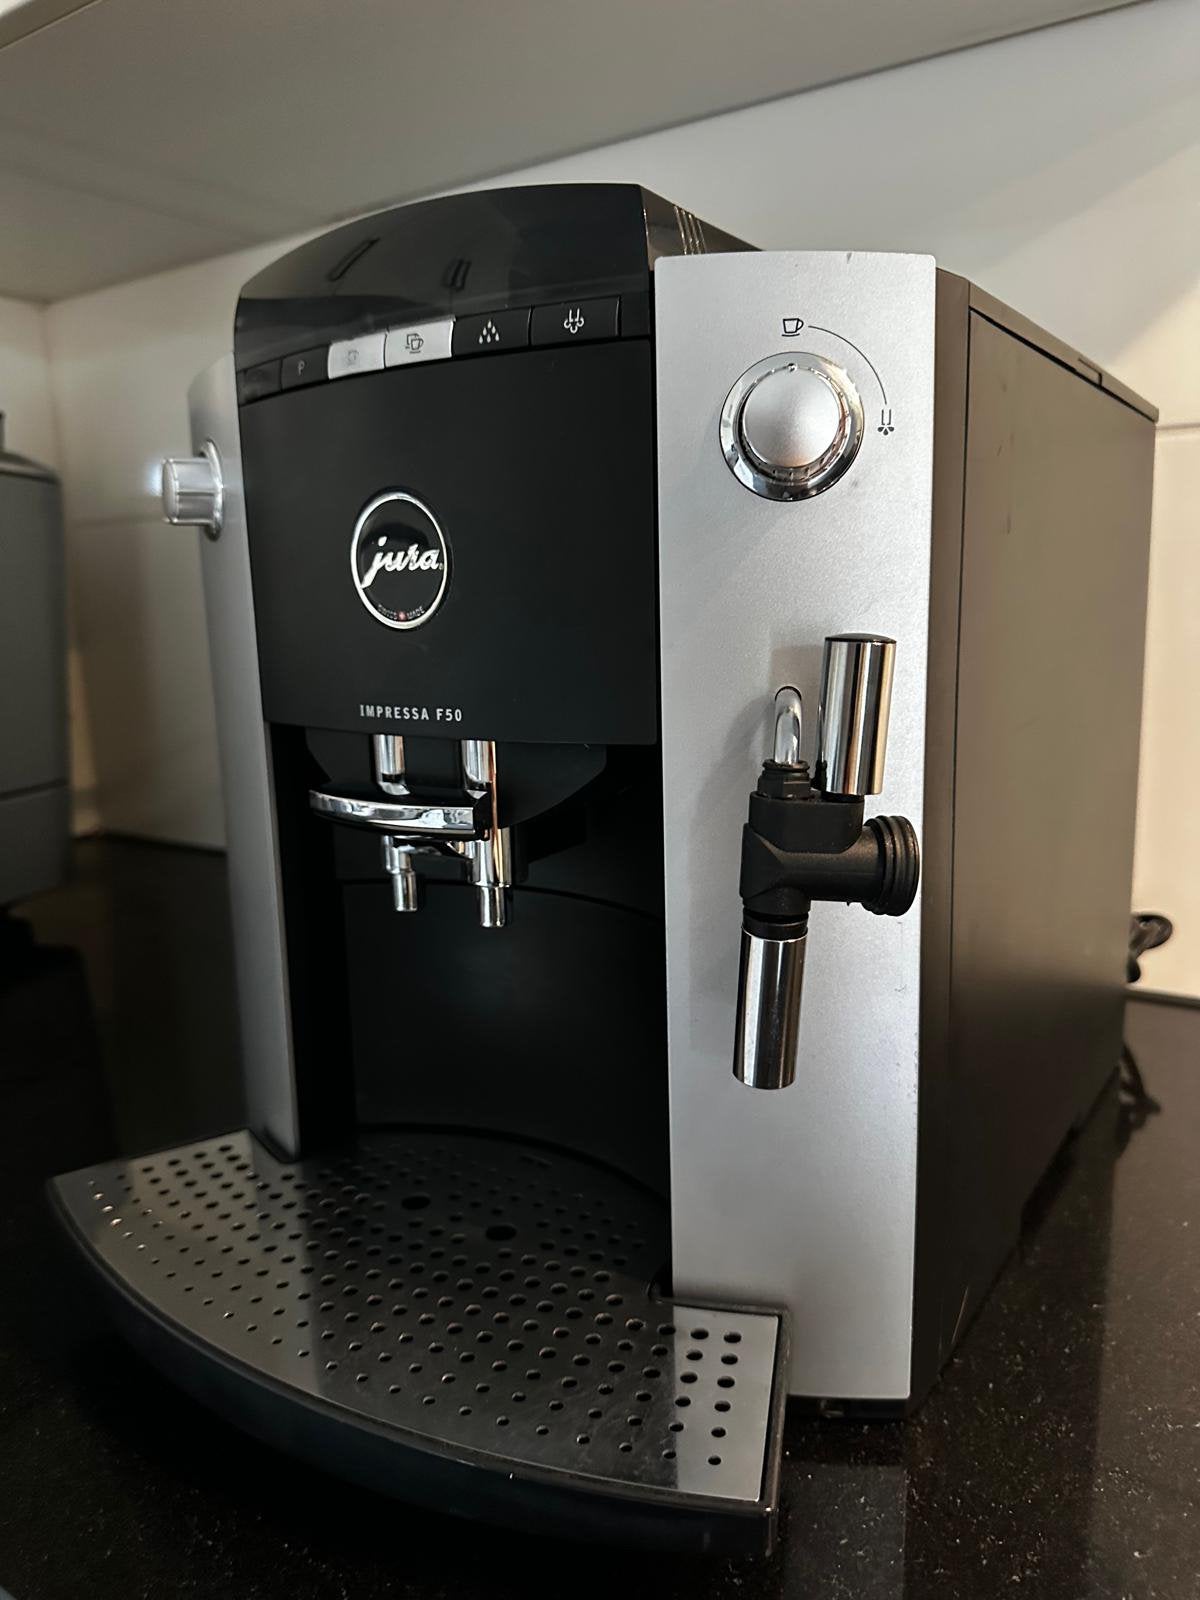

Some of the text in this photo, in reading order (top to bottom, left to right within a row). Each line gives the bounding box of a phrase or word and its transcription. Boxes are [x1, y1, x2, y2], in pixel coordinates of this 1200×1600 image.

[360, 536, 440, 589] jura
[360, 704, 462, 722] IMPRESSA F50
